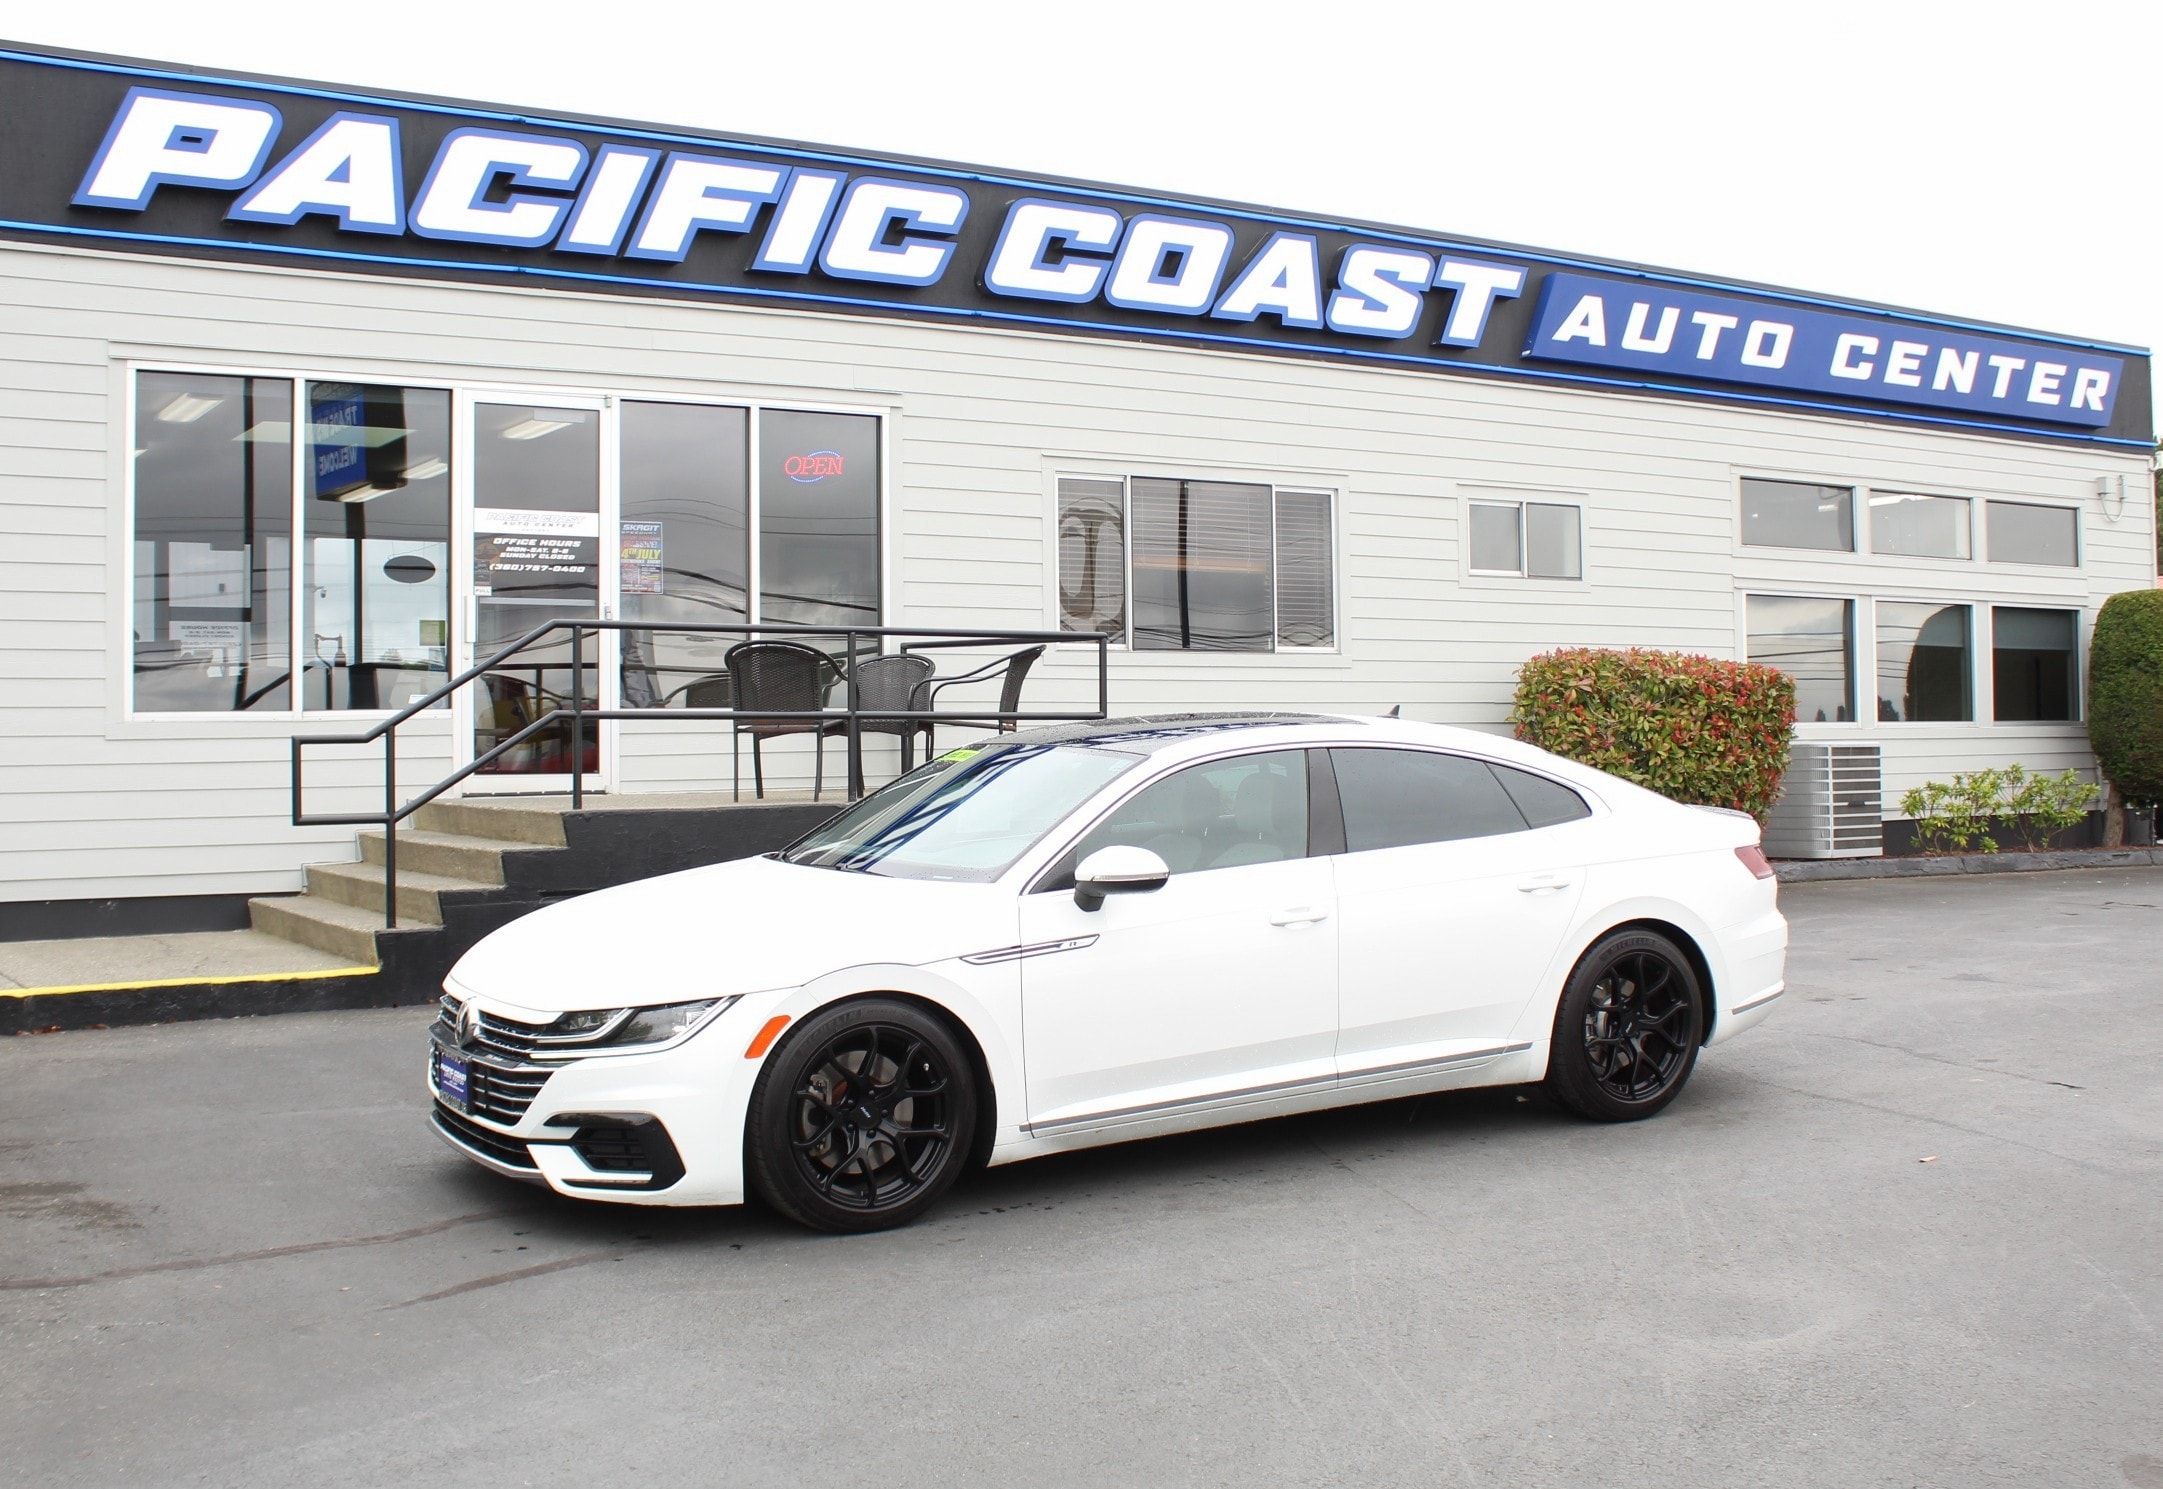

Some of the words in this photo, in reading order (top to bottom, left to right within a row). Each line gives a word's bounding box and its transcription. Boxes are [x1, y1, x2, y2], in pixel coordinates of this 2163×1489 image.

[69, 85, 970, 287] PACIFIC
[982, 197, 1529, 348] COAST
[1552, 295, 1794, 369] AUTO
[1830, 333, 2111, 411] CENTER
[784, 456, 844, 475] OPEN
[486, 512, 538, 523] PACIFIC
[541, 514, 586, 525] COAST
[493, 538, 537, 546] OFFICE
[539, 539, 582, 548] HOURS
[636, 549, 661, 560] JULY
